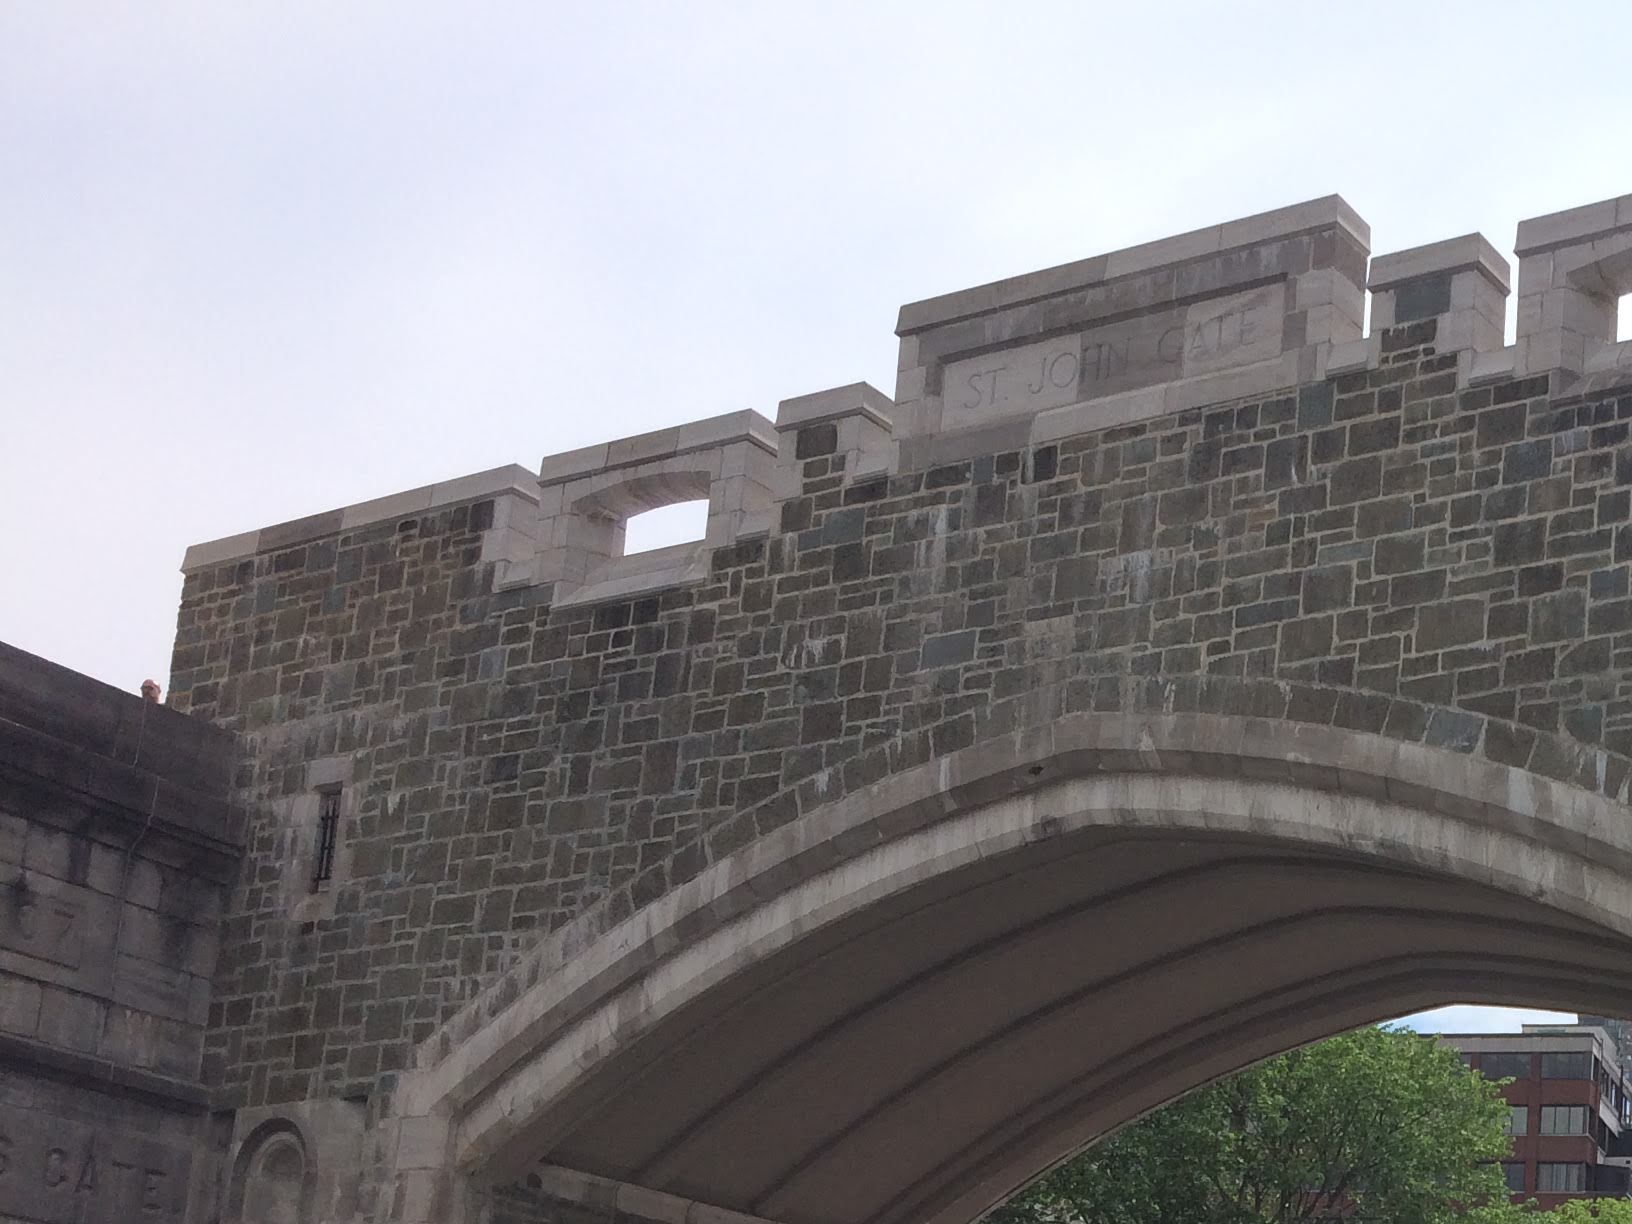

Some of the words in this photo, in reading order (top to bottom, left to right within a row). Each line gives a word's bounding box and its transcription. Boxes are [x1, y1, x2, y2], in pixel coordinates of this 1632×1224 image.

[963, 366, 1009, 409] ST.
[1028, 336, 1131, 395] JOHN
[1156, 312, 1257, 364] GATE
